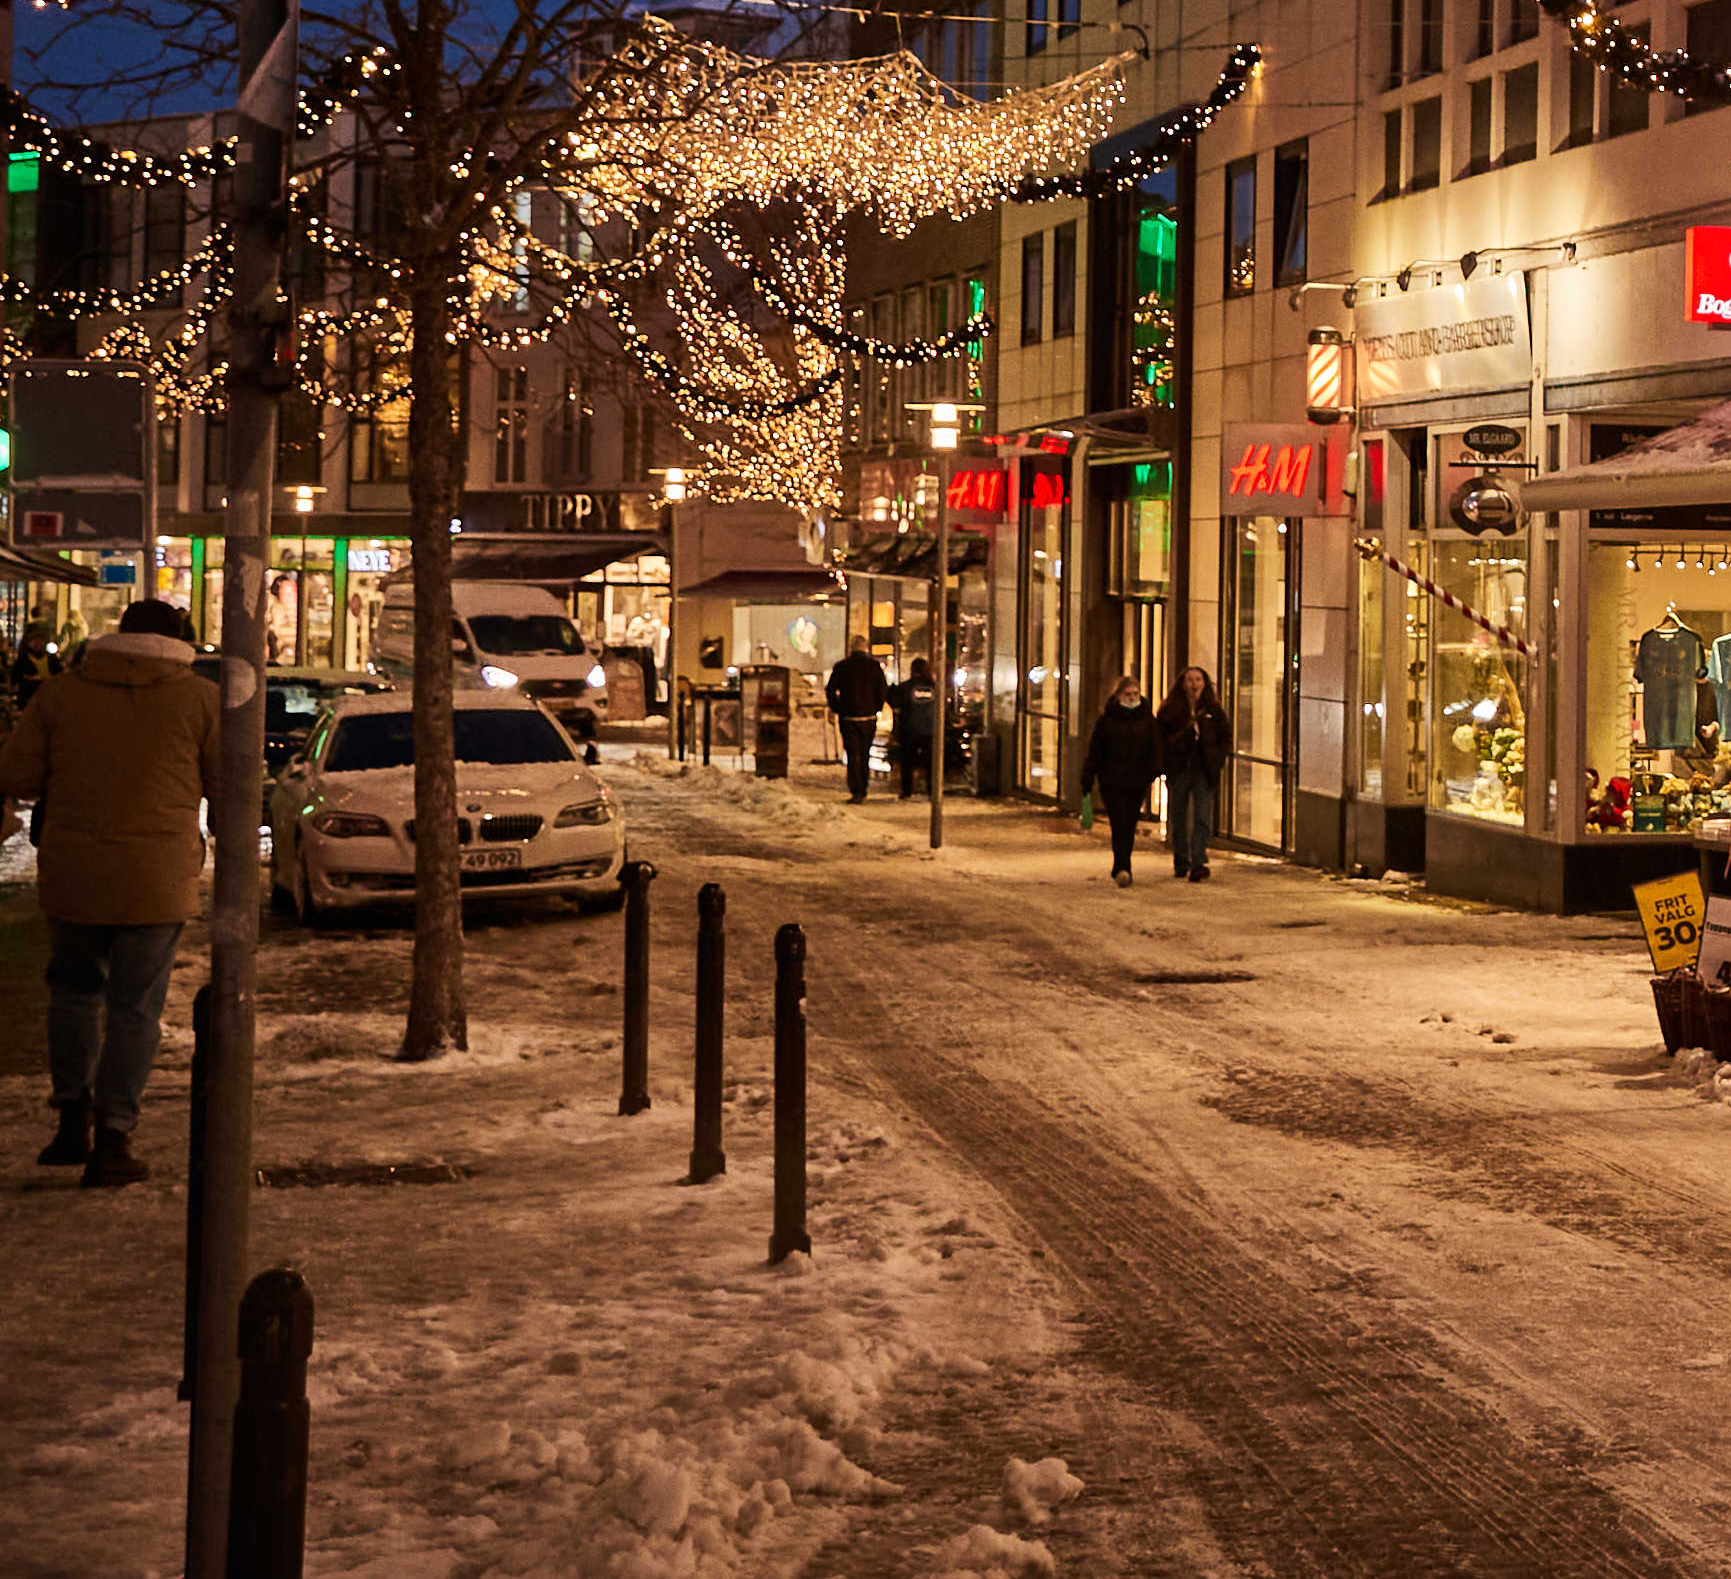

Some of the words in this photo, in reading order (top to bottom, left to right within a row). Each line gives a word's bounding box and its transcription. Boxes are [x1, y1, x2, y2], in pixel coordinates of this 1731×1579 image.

[1230, 442, 1313, 498] H&M
[945, 470, 1001, 511] H&M
[521, 493, 615, 529] TIPPY
[1654, 905, 1696, 925] VALG
[1655, 893, 1688, 912] FRIT
